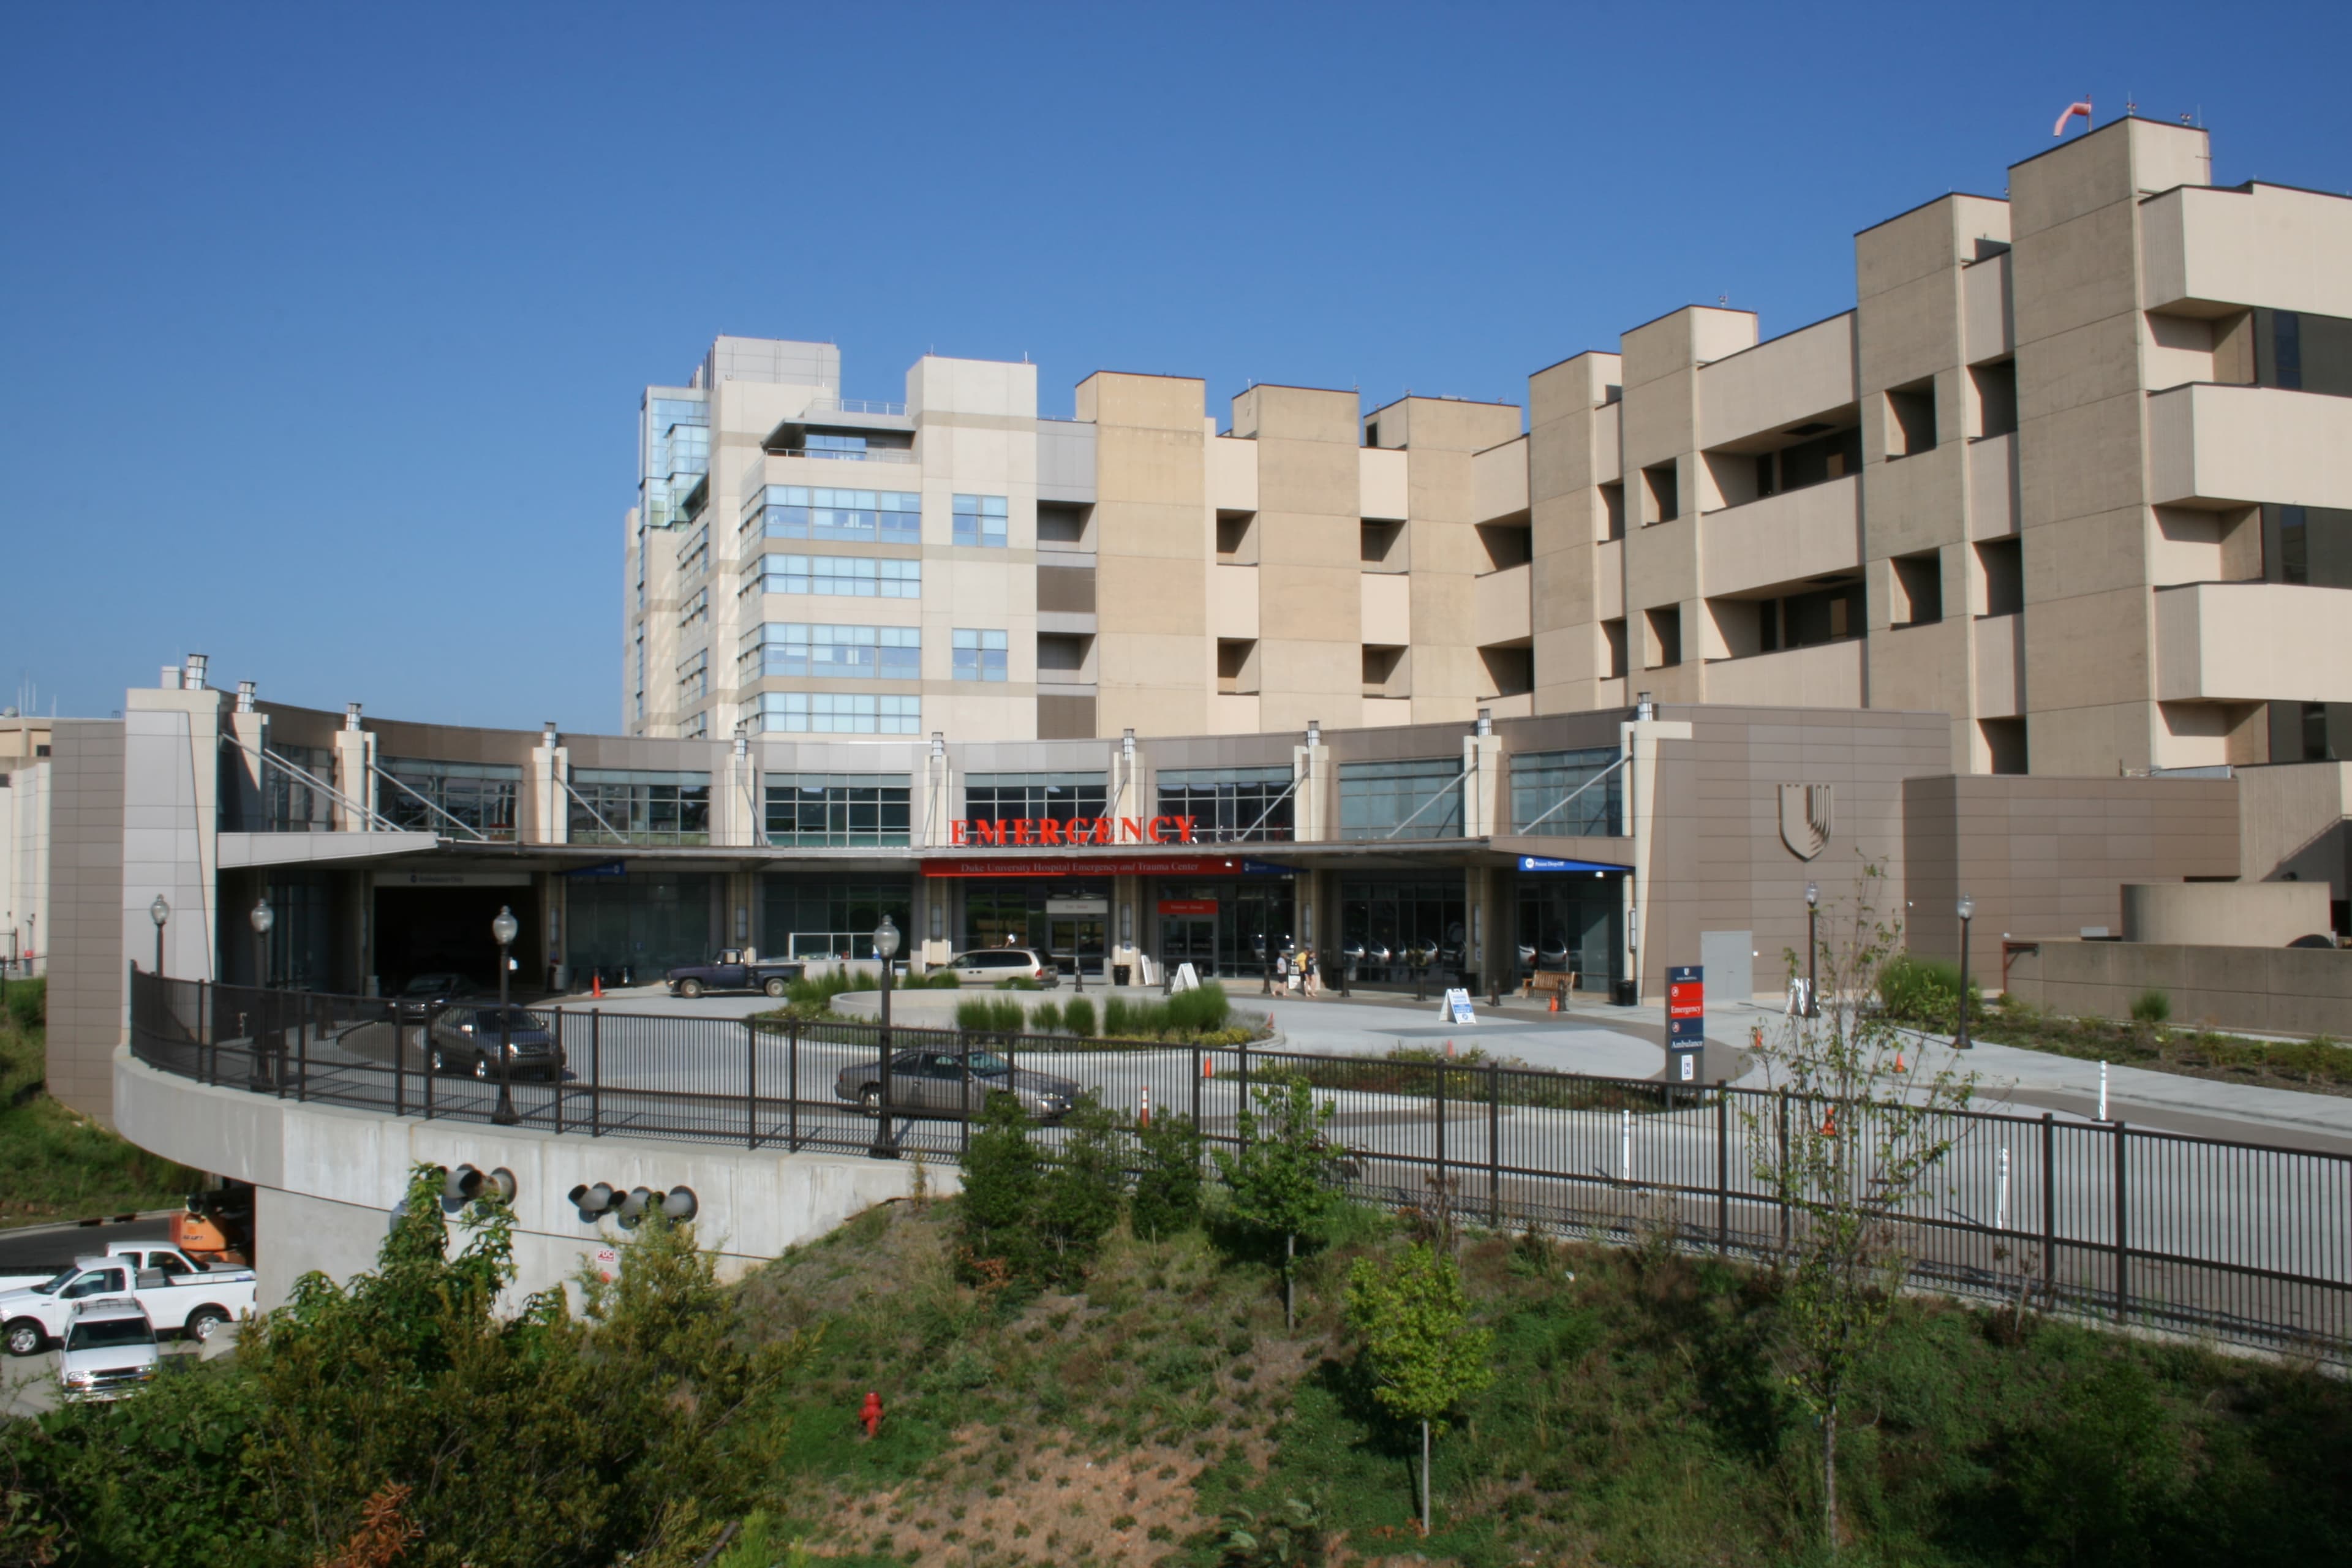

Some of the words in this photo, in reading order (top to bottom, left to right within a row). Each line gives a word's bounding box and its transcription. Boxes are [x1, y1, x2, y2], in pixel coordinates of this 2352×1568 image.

[949, 815, 1197, 845] EMERGENCY
[960, 863, 984, 872] Duke
[987, 863, 1030, 873] University
[1033, 862, 1070, 873] Hospital
[1072, 862, 1117, 872] Emergency
[1120, 862, 1136, 871] and
[1138, 862, 1169, 871] Trauma
[1171, 861, 1199, 871] Center
[1670, 1006, 1701, 1014] Emergency
[1671, 1040, 1703, 1049] Ambulance
